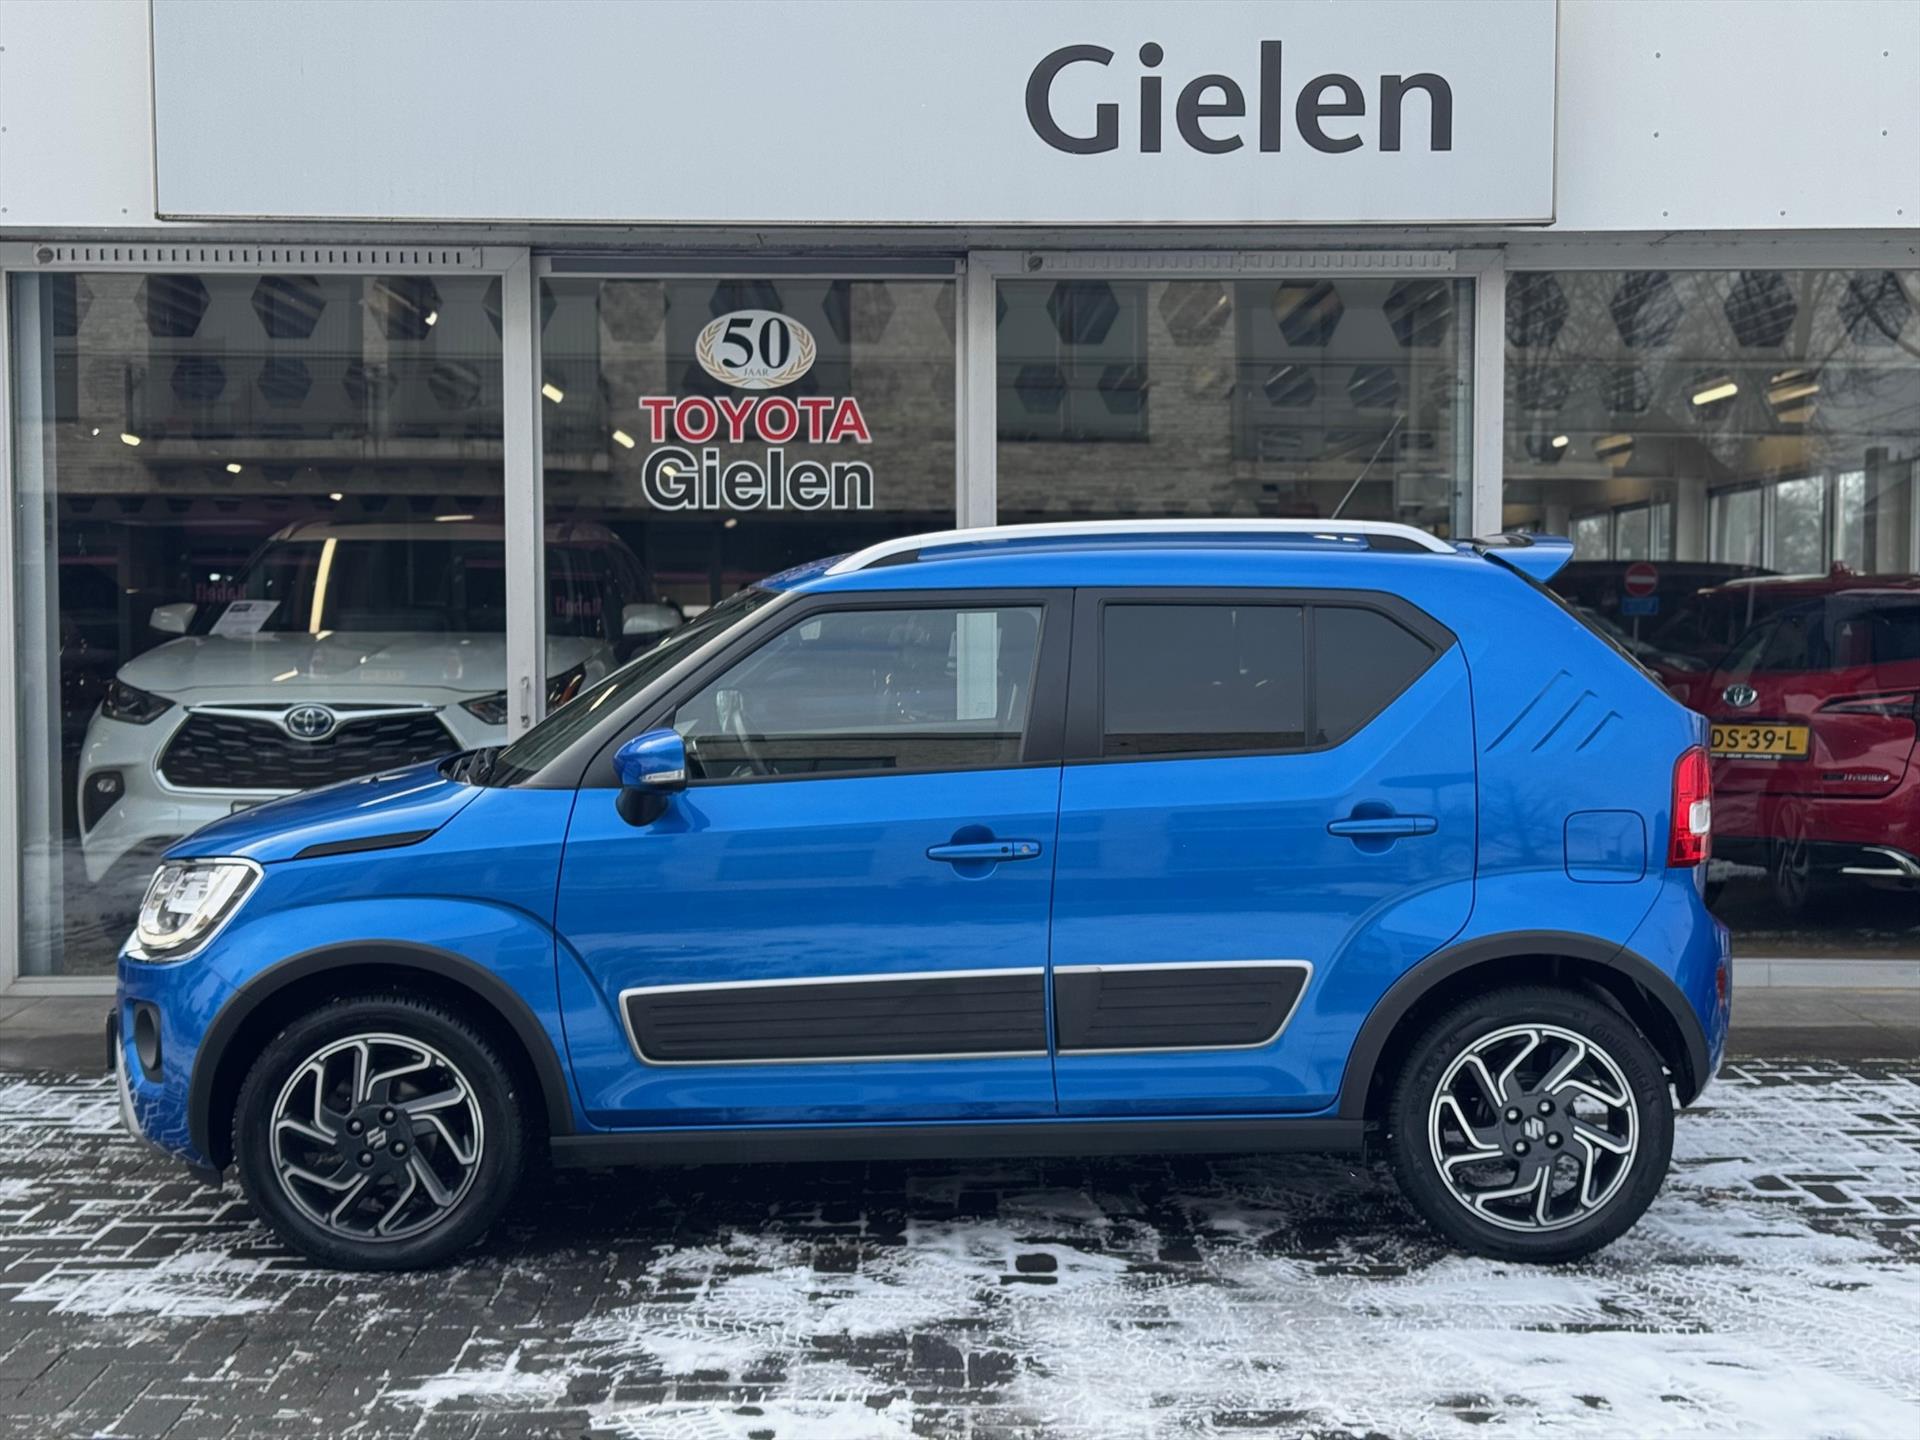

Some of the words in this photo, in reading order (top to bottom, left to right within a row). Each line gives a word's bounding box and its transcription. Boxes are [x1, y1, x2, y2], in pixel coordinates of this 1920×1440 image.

[1025, 40, 1453, 154] Gielen
[722, 317, 790, 369] 50
[744, 367, 769, 377] JAAR
[639, 395, 872, 443] TOYOTA
[642, 446, 874, 511] Gielen
[1711, 728, 1797, 750] DS-39-L
